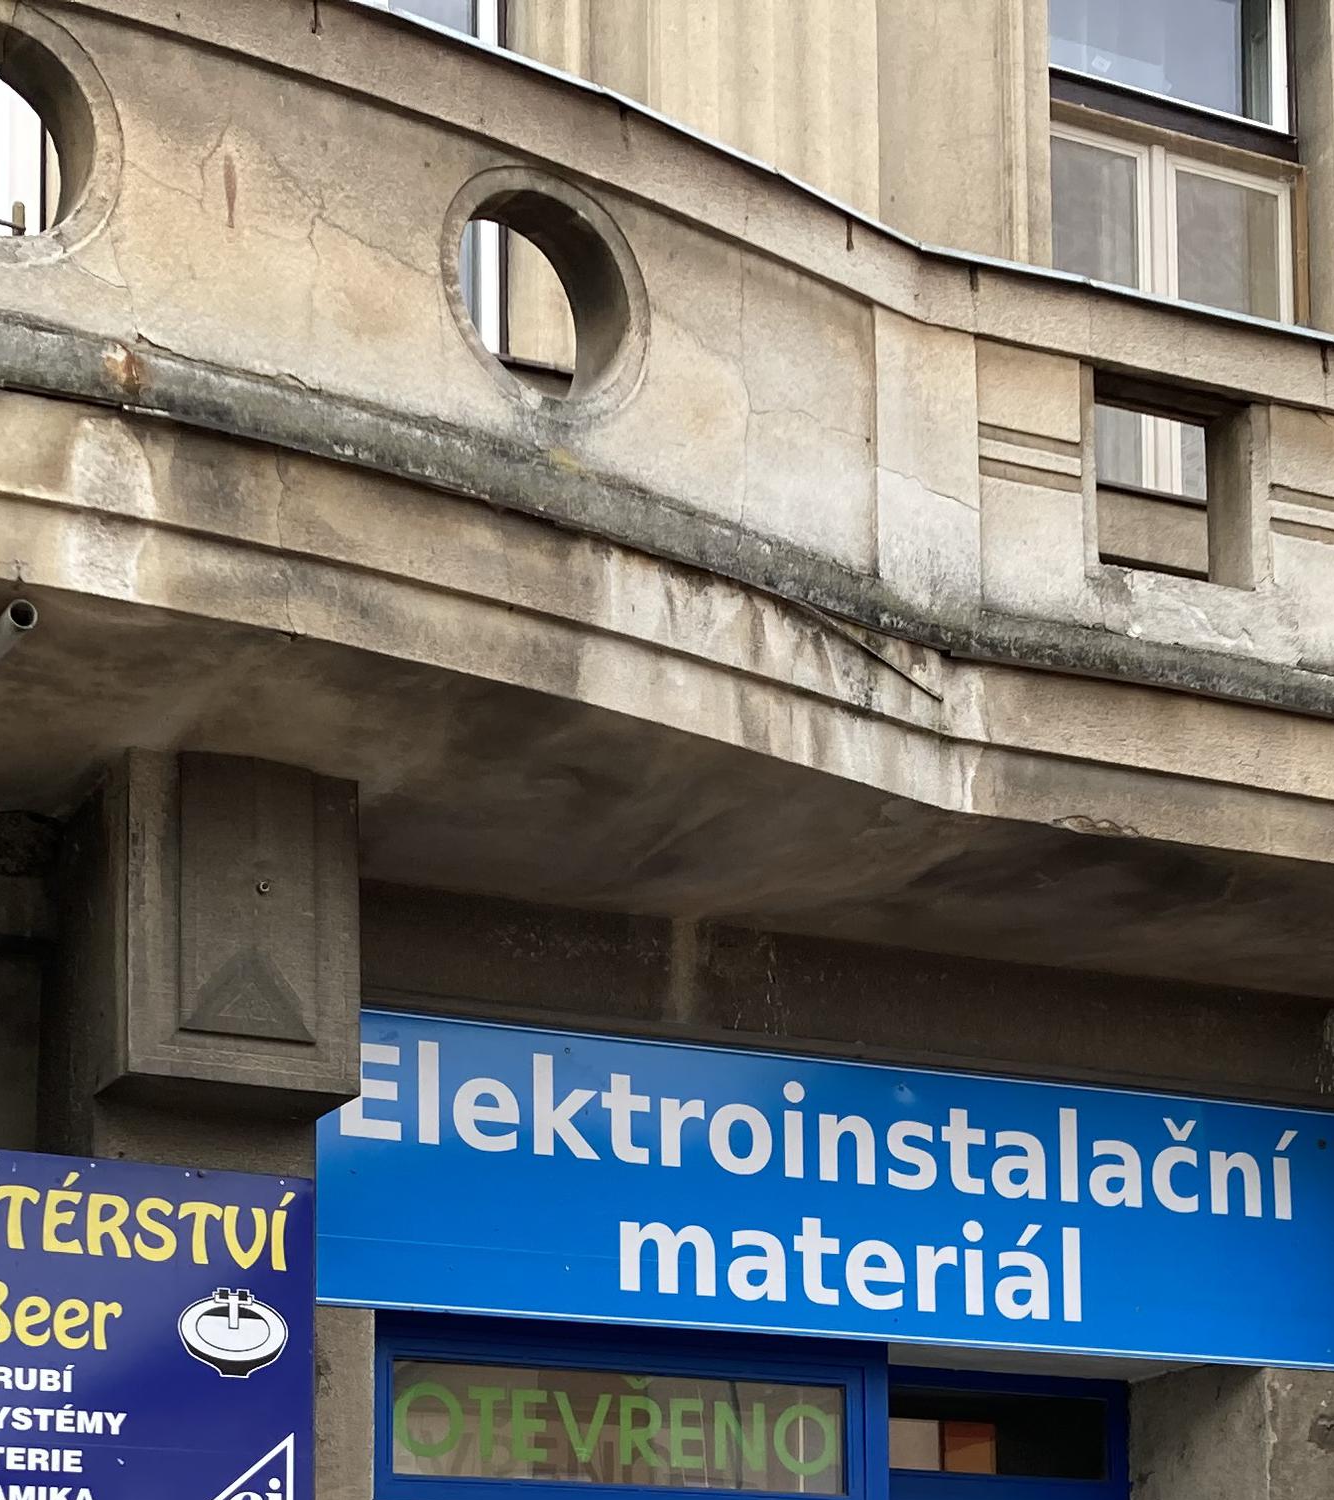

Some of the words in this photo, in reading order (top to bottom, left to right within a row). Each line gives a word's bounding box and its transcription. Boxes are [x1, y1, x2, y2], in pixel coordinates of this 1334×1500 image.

[340, 1040, 1295, 1221] Elektroinstalační
[619, 1216, 1082, 1322] materiál
[394, 1376, 837, 1476] OTEVŘENO
